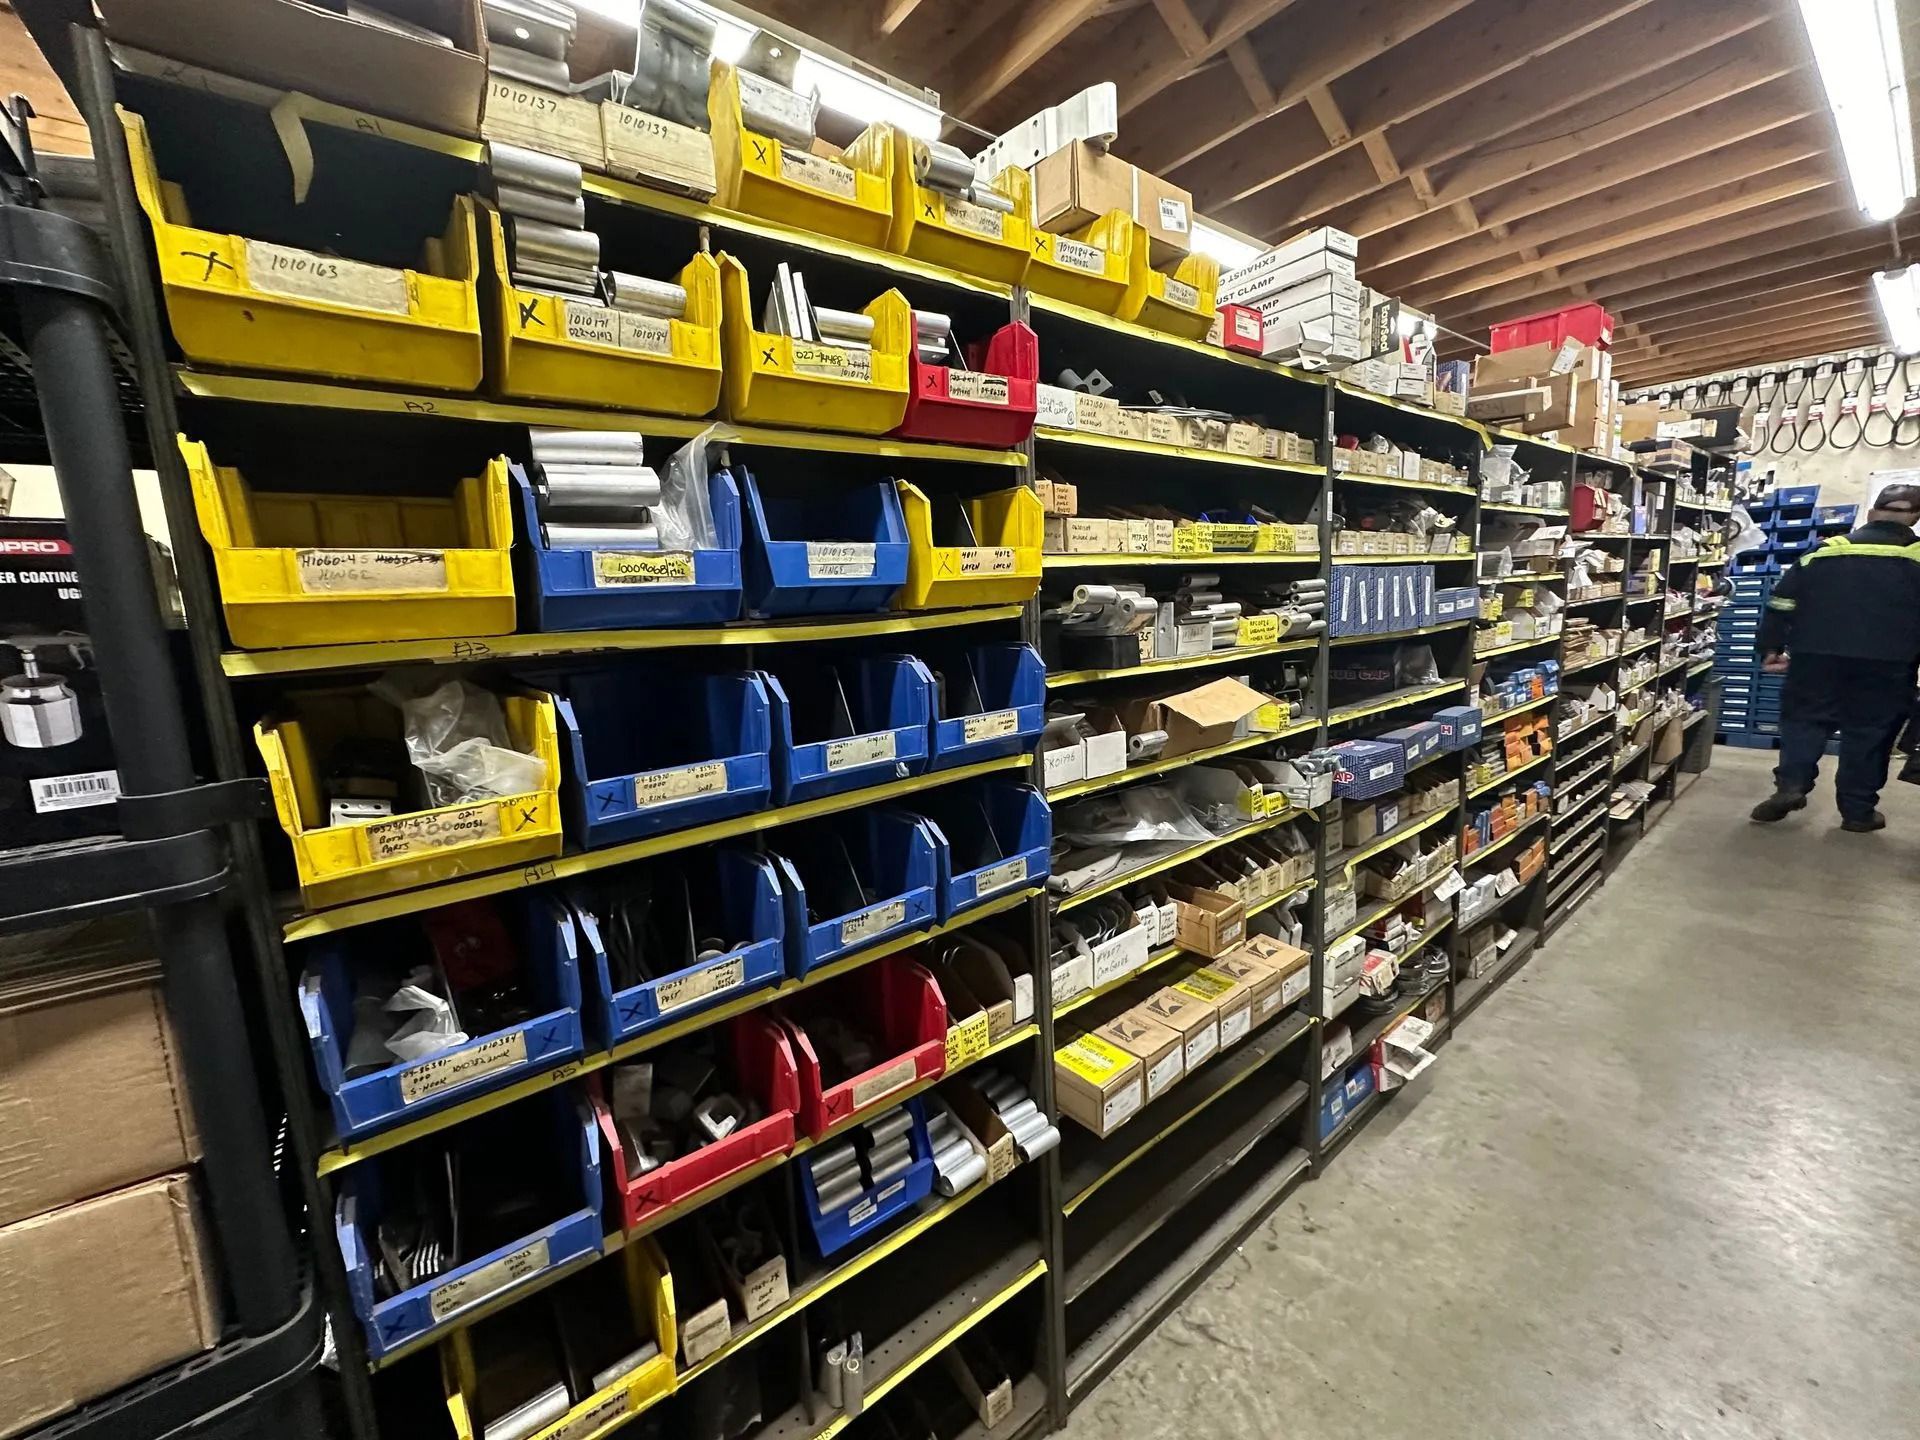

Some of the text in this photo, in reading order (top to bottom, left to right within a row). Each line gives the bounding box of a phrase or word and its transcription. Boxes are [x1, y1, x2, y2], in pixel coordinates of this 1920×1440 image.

[492, 83, 557, 113] 1010137
[619, 111, 668, 138] 1010139
[271, 254, 338, 279] 1010163
[1237, 276, 1275, 296] CLAMP
[404, 401, 439, 414] A2
[0, 541, 59, 553] PRO
[818, 564, 847, 575] HINGE
[57, 588, 82, 600] UG
[452, 640, 491, 658] A3
[524, 864, 556, 884] A4
[552, 1066, 577, 1082] A5
